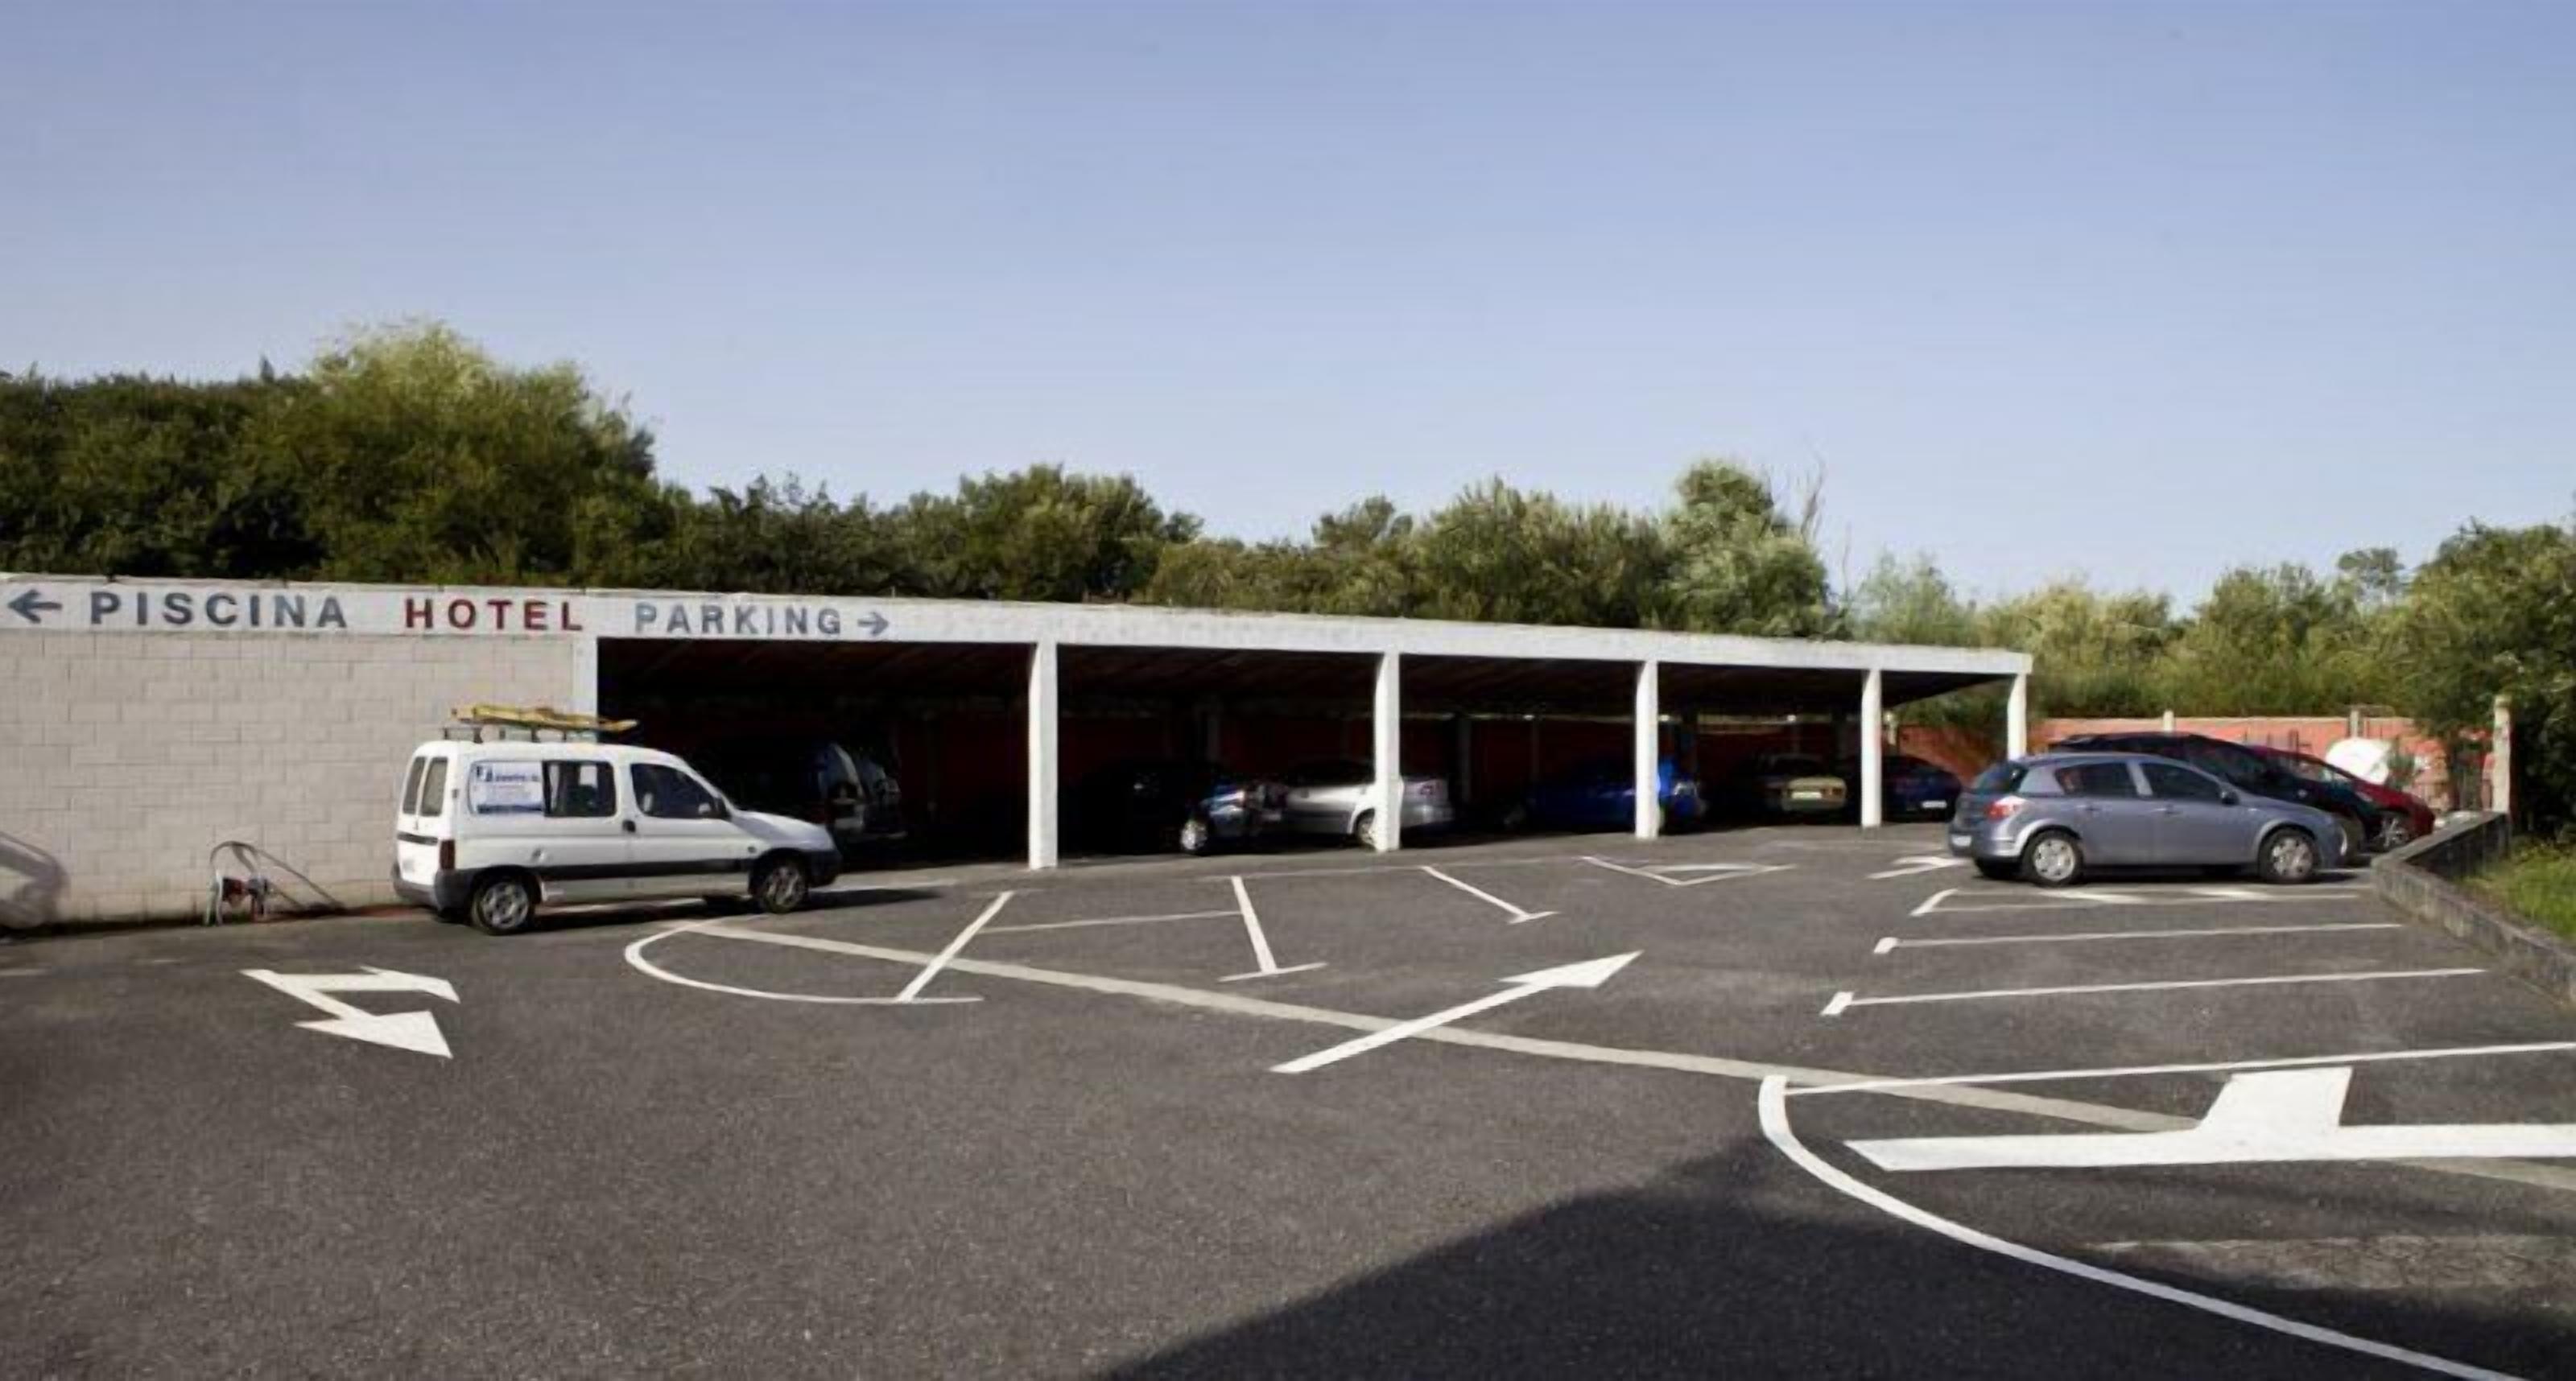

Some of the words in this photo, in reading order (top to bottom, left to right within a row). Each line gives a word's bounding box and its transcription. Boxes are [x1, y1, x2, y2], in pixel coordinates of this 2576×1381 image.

[90, 592, 347, 628] PISCINA
[406, 598, 583, 631] HOTEL
[635, 602, 840, 634] PARKING
